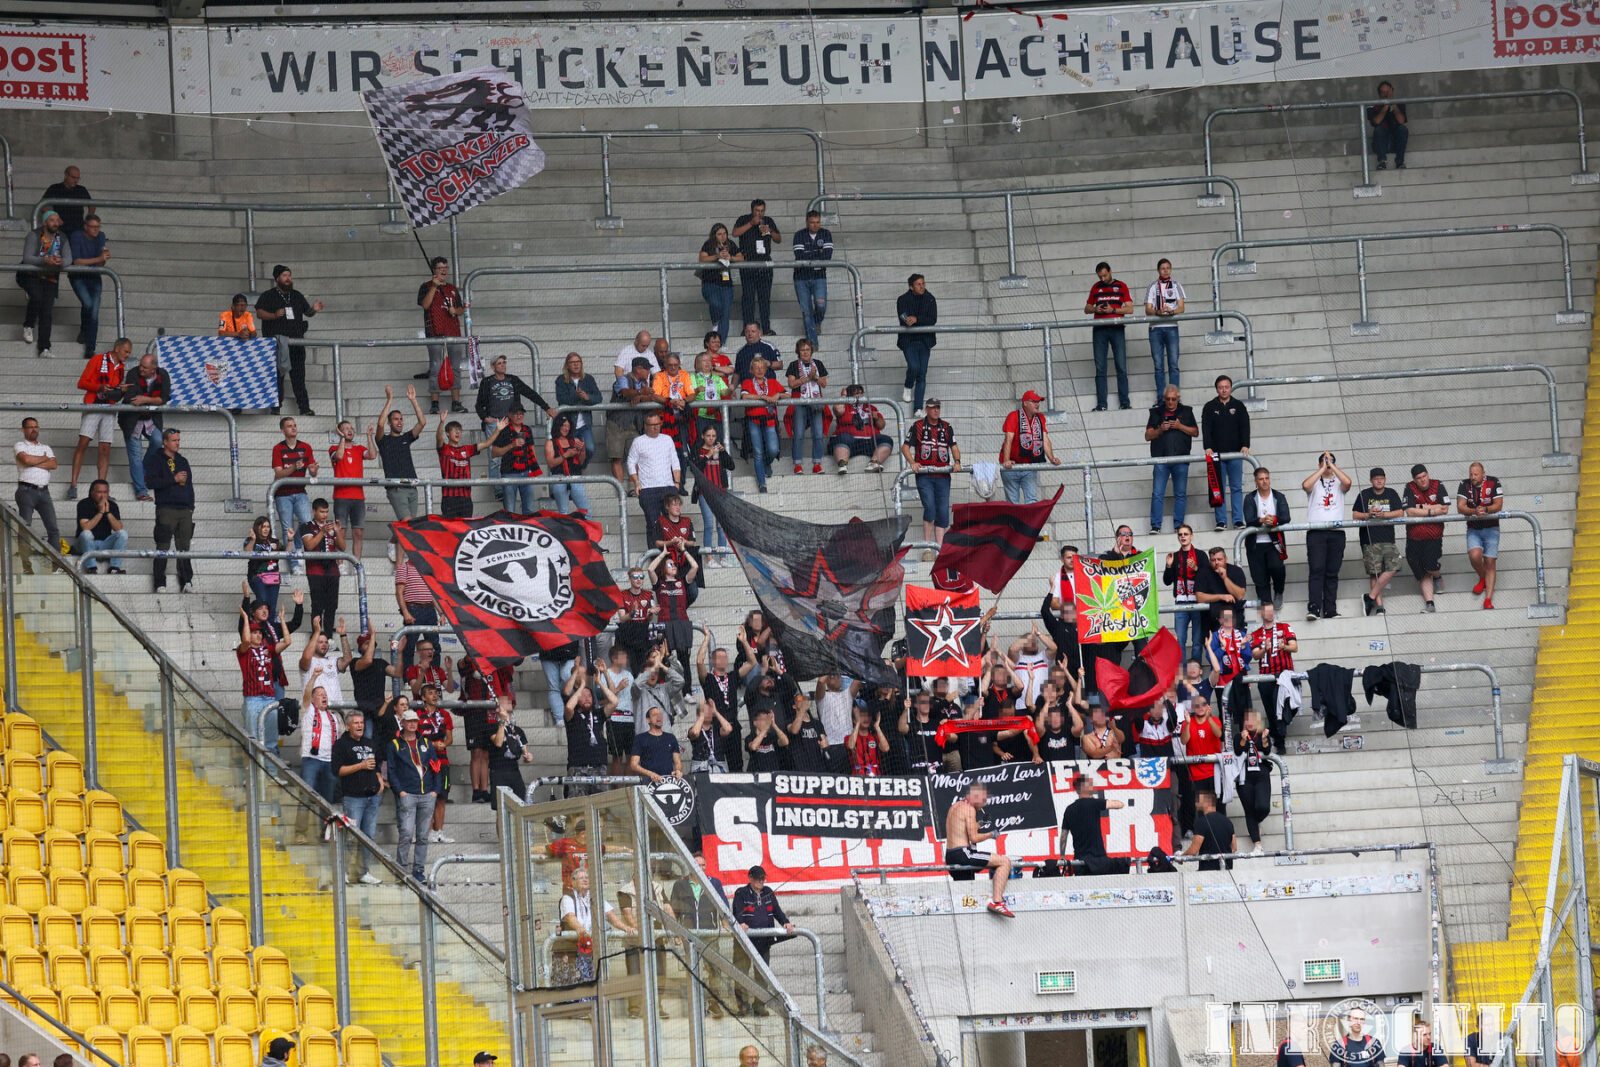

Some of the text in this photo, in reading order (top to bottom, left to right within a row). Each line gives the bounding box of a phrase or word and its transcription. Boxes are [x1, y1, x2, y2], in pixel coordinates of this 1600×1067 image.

[261, 50, 383, 93] WIR
[414, 46, 711, 91] SCHICKEN
[742, 43, 892, 86] EUCH
[924, 31, 1090, 81] NACH
[1121, 19, 1320, 71] HAUSE
[3, 84, 78, 96] ODERN
[399, 132, 499, 180] TORKEL
[426, 135, 528, 213] SCHANZER
[1080, 557, 1148, 577] Schanzer
[474, 573, 572, 619] INGOLSTADT
[1084, 609, 1148, 638] Lifestyle
[774, 775, 922, 797] SUPPORTERS
[931, 765, 1044, 792] Mofo und Lars
[1052, 758, 1132, 791] FKS
[775, 807, 923, 830] INGOLSTADT
